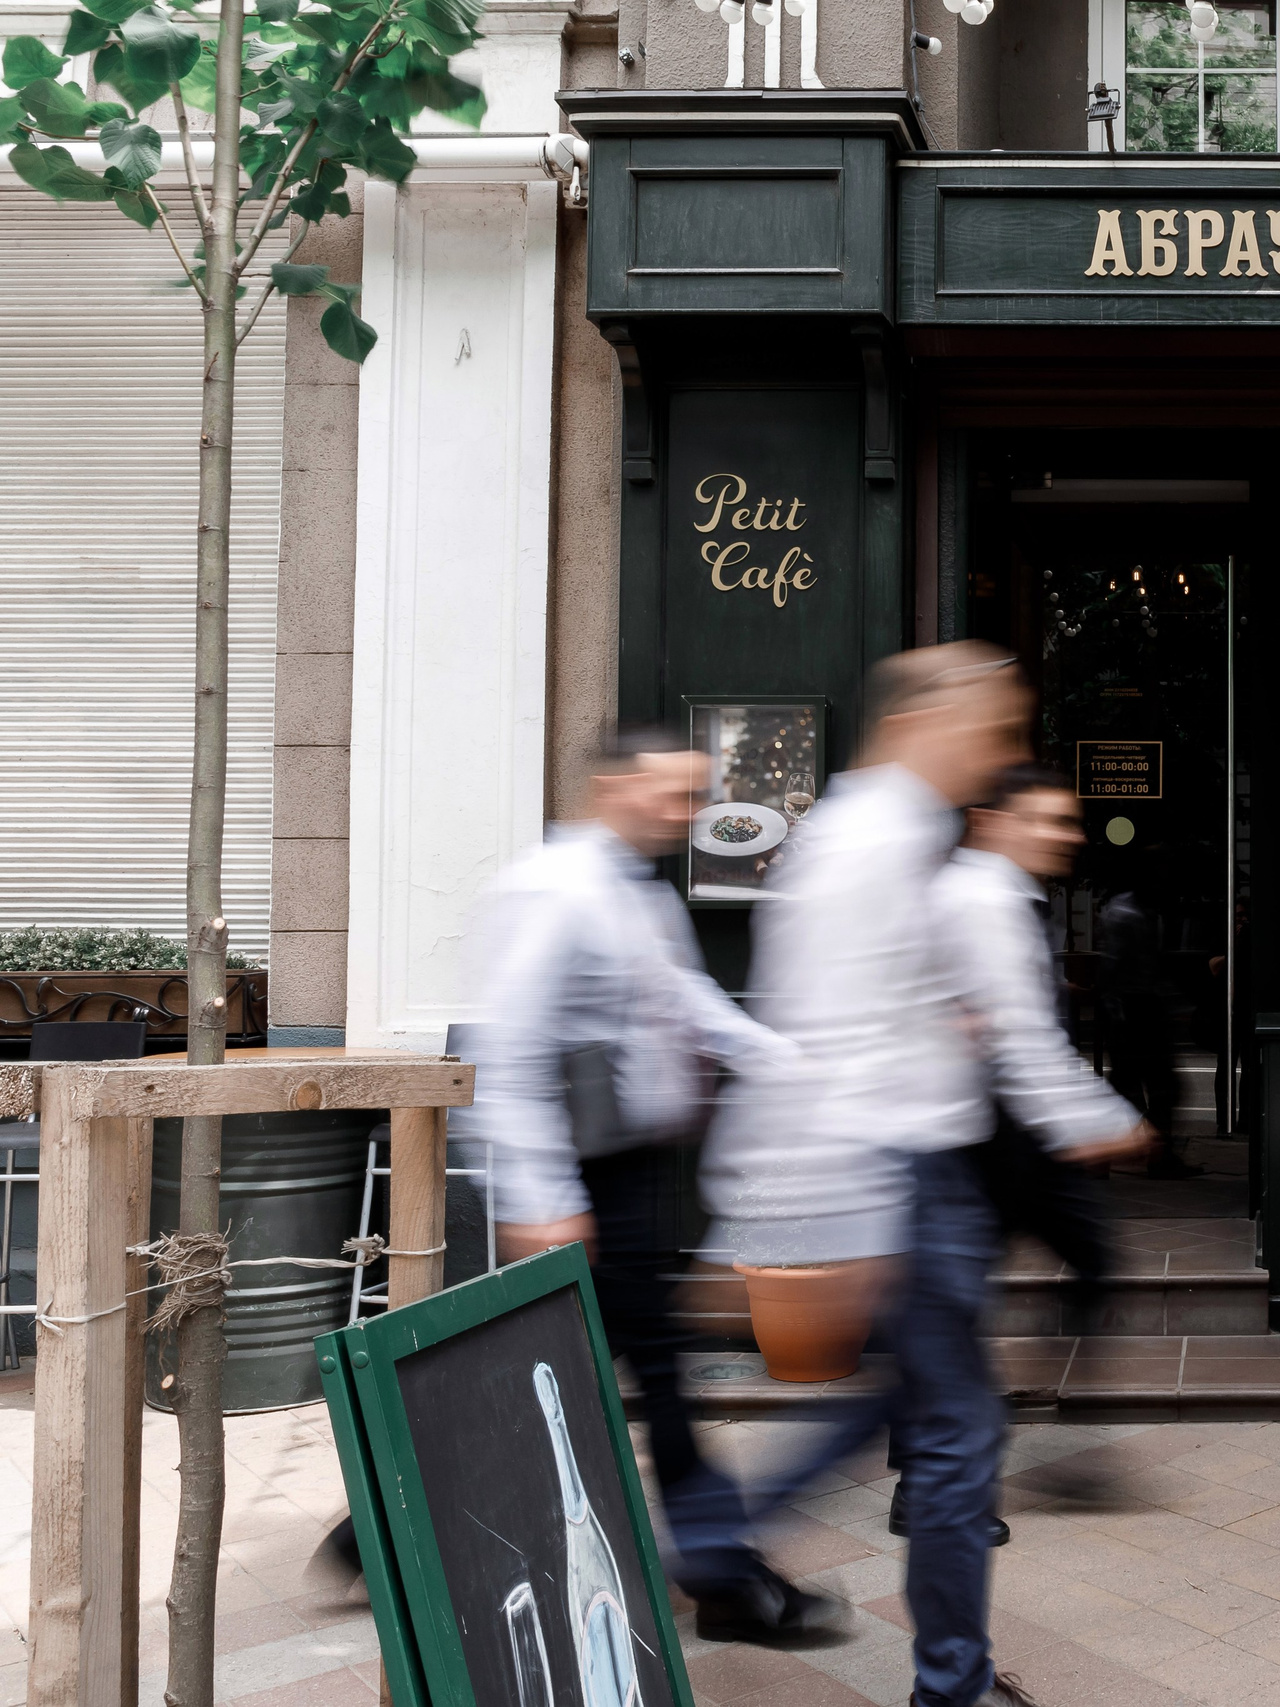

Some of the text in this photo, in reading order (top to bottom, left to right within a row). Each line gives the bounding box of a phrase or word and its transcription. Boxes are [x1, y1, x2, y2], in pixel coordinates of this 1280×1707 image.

[693, 473, 808, 533] Petit
[700, 540, 818, 608] Cafè
[1090, 762, 1149, 771] 11:00-00:00
[1090, 784, 1149, 793] 11:00-01:00
